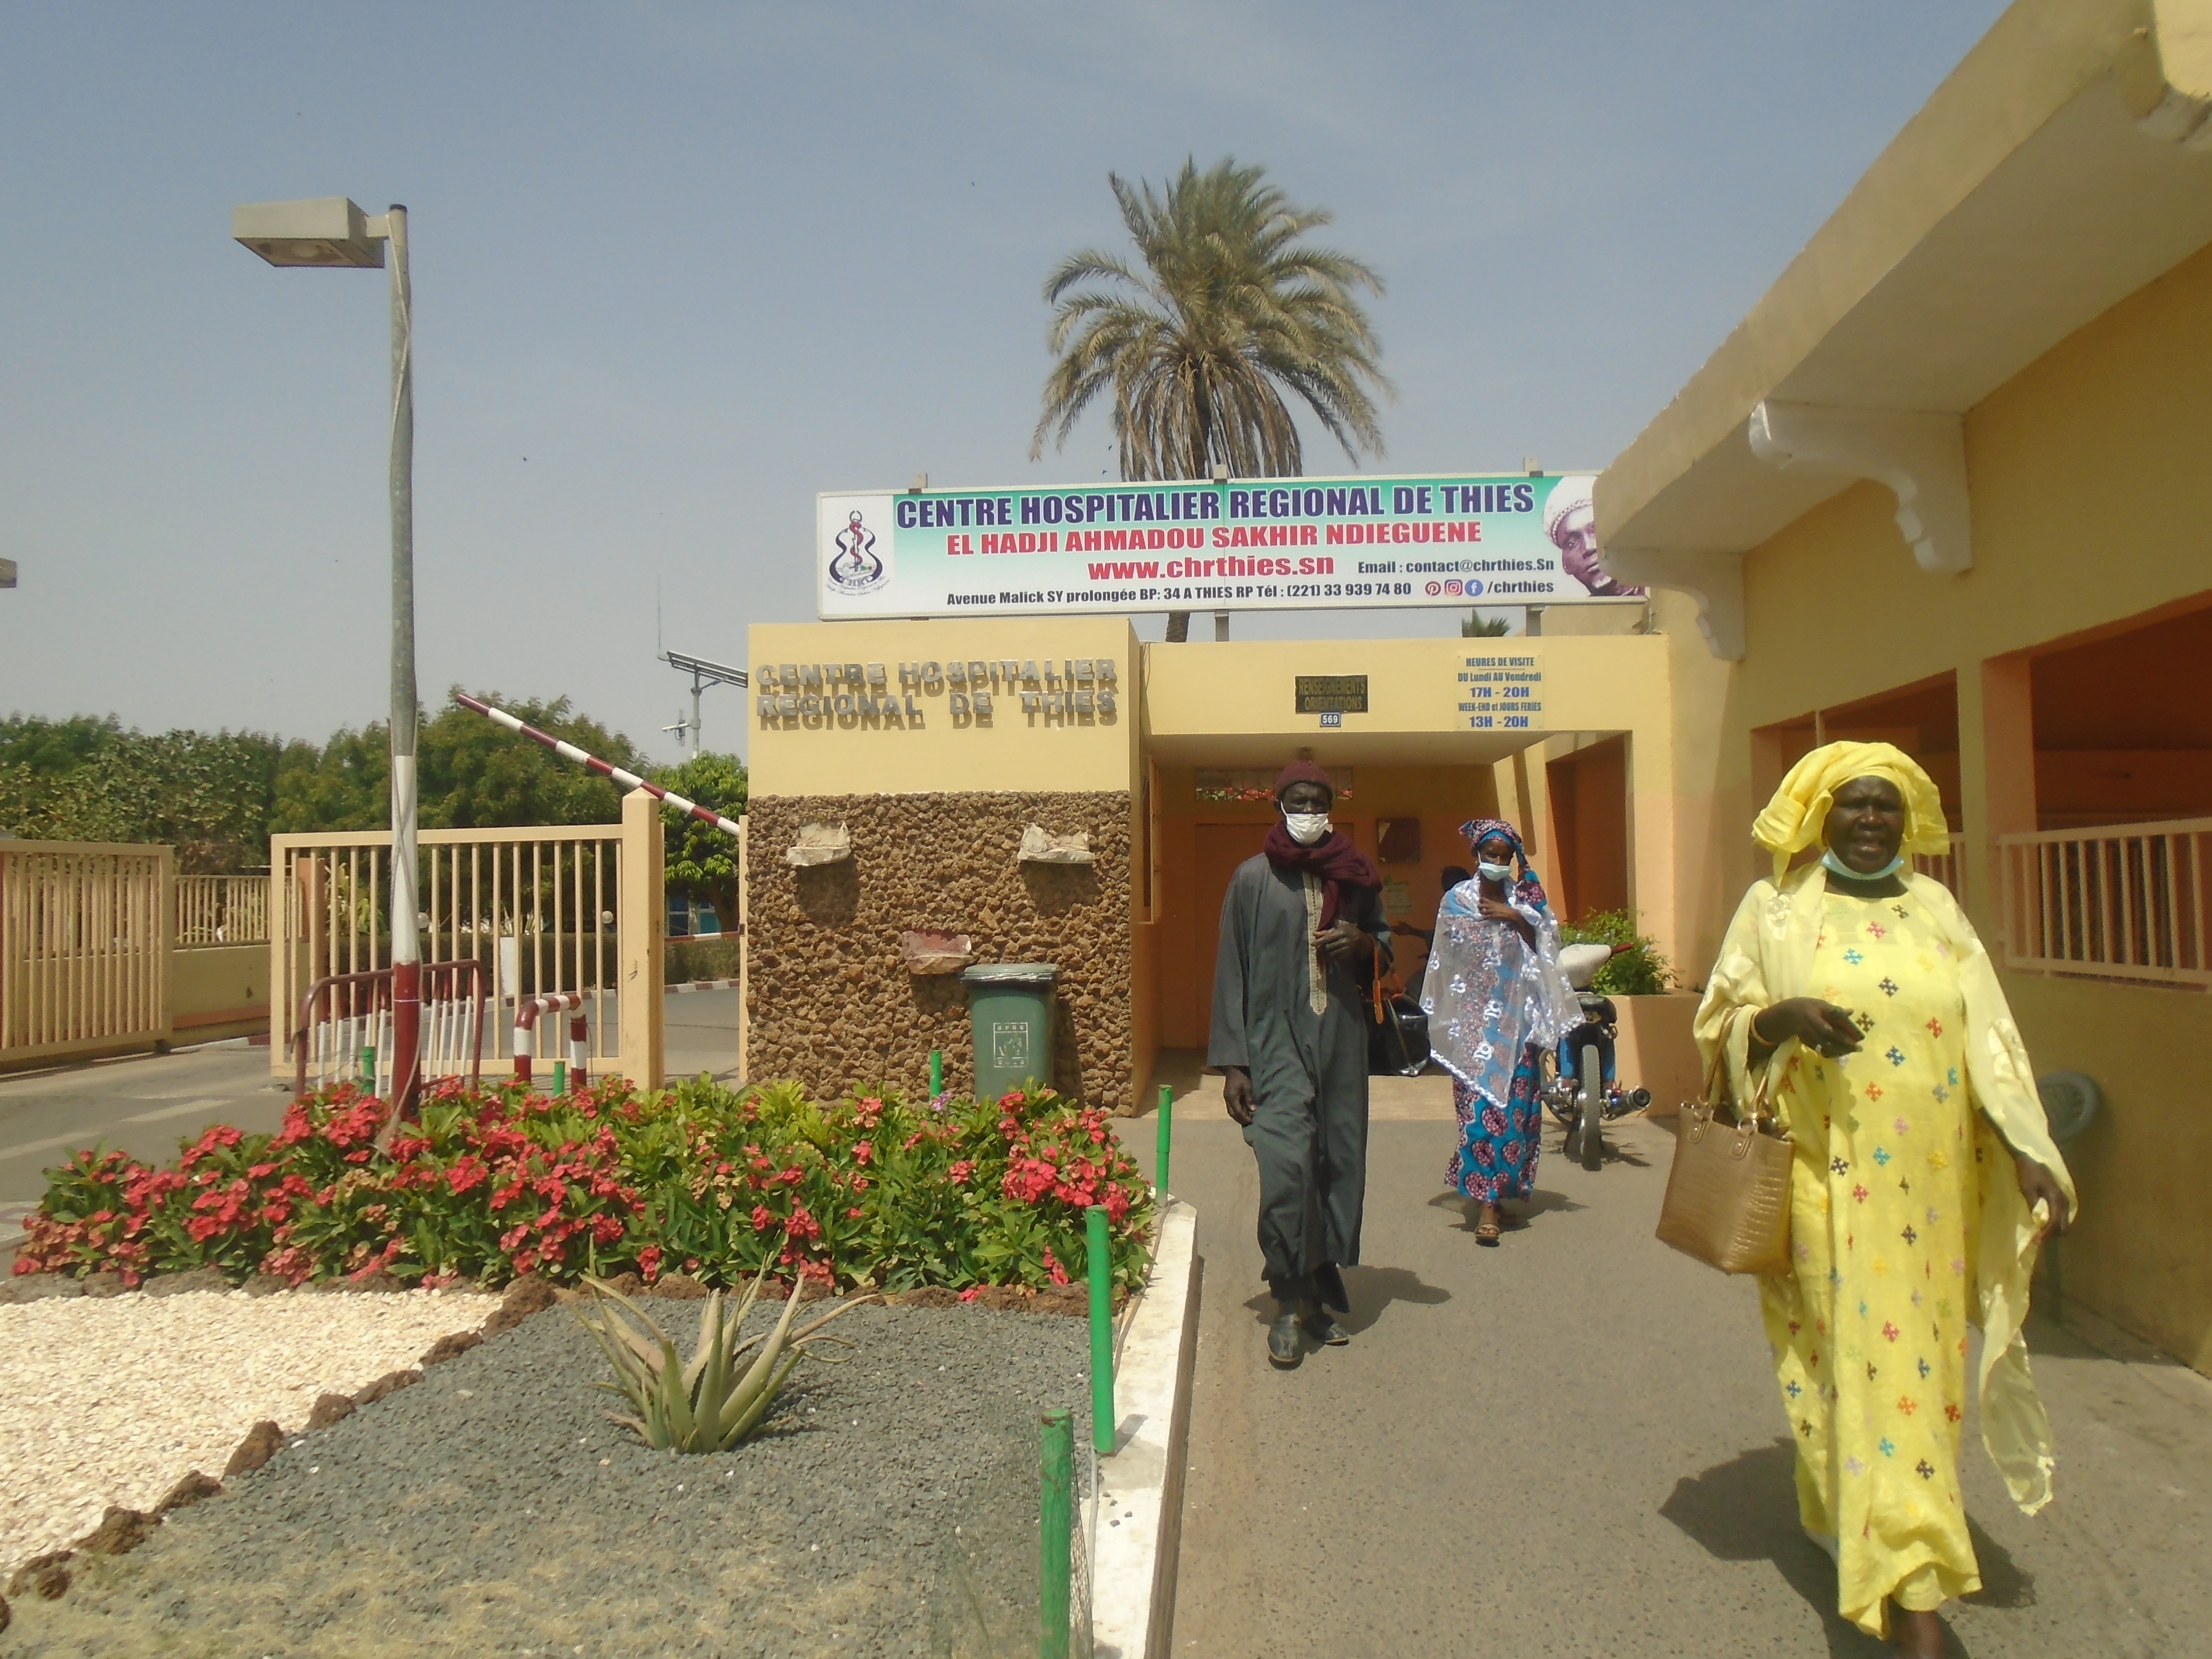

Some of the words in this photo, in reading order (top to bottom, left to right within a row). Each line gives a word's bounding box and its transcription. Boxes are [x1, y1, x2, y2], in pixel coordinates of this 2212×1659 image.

[897, 497, 1012, 529] CENTRE
[1021, 492, 1220, 524] HOSPITALIER
[1230, 487, 1385, 518] REGIONAL
[1393, 486, 1432, 514] DE
[1440, 483, 1534, 513] THIES
[947, 534, 974, 555] EL
[981, 532, 1058, 554] HADJI
[1065, 528, 1204, 552] AHMADOU
[1212, 524, 1318, 548] SAKHIR
[1326, 521, 1482, 544] NDIEGUENE
[1088, 556, 1334, 580] www.chrthies.sn
[1358, 561, 1396, 573] Email
[1406, 558, 1554, 573] contact@chrthies.Sn
[947, 593, 996, 605] Avenue
[1000, 591, 1044, 604] Malick
[1047, 591, 1063, 602] SY
[1066, 589, 1136, 603] prolongée
[1139, 588, 1160, 600] BP:
[1164, 587, 1181, 599] 34
[1183, 587, 1192, 599] A
[1195, 586, 1233, 599] THIES
[1236, 586, 1253, 598] RP
[1256, 584, 1277, 597] Tél
[1287, 584, 1320, 597] (221)
[1324, 583, 1342, 596] 33
[1345, 583, 1372, 596] 939
[1376, 583, 1390, 595] 74
[1393, 582, 1412, 595] 80
[1487, 580, 1554, 594] /chrthies
[1466, 657, 1496, 666] HEURES
[1498, 657, 1507, 666] DE
[1509, 656, 1534, 666] VISITE
[756, 662, 885, 685] CENTRE
[899, 658, 1116, 683] HOSPITALIER
[1458, 672, 1468, 682] DU
[1470, 672, 1492, 682] Lundi
[1493, 672, 1503, 681] AU
[1505, 672, 1541, 681] Vendredi
[1469, 687, 1492, 698] 17H
[1503, 686, 1530, 697] 20H
[757, 694, 923, 716] REGIONAL
[949, 691, 991, 714] DE
[1019, 690, 1116, 713] THIES
[1304, 696, 1362, 710] ORIENTATIONS
[1458, 702, 1490, 711] WEEK-END
[1492, 702, 1498, 711] et
[1500, 702, 1519, 711] JOURS
[1322, 715, 1338, 723] 569
[1469, 716, 1492, 727] 13H
[1504, 715, 1528, 727] 20H
